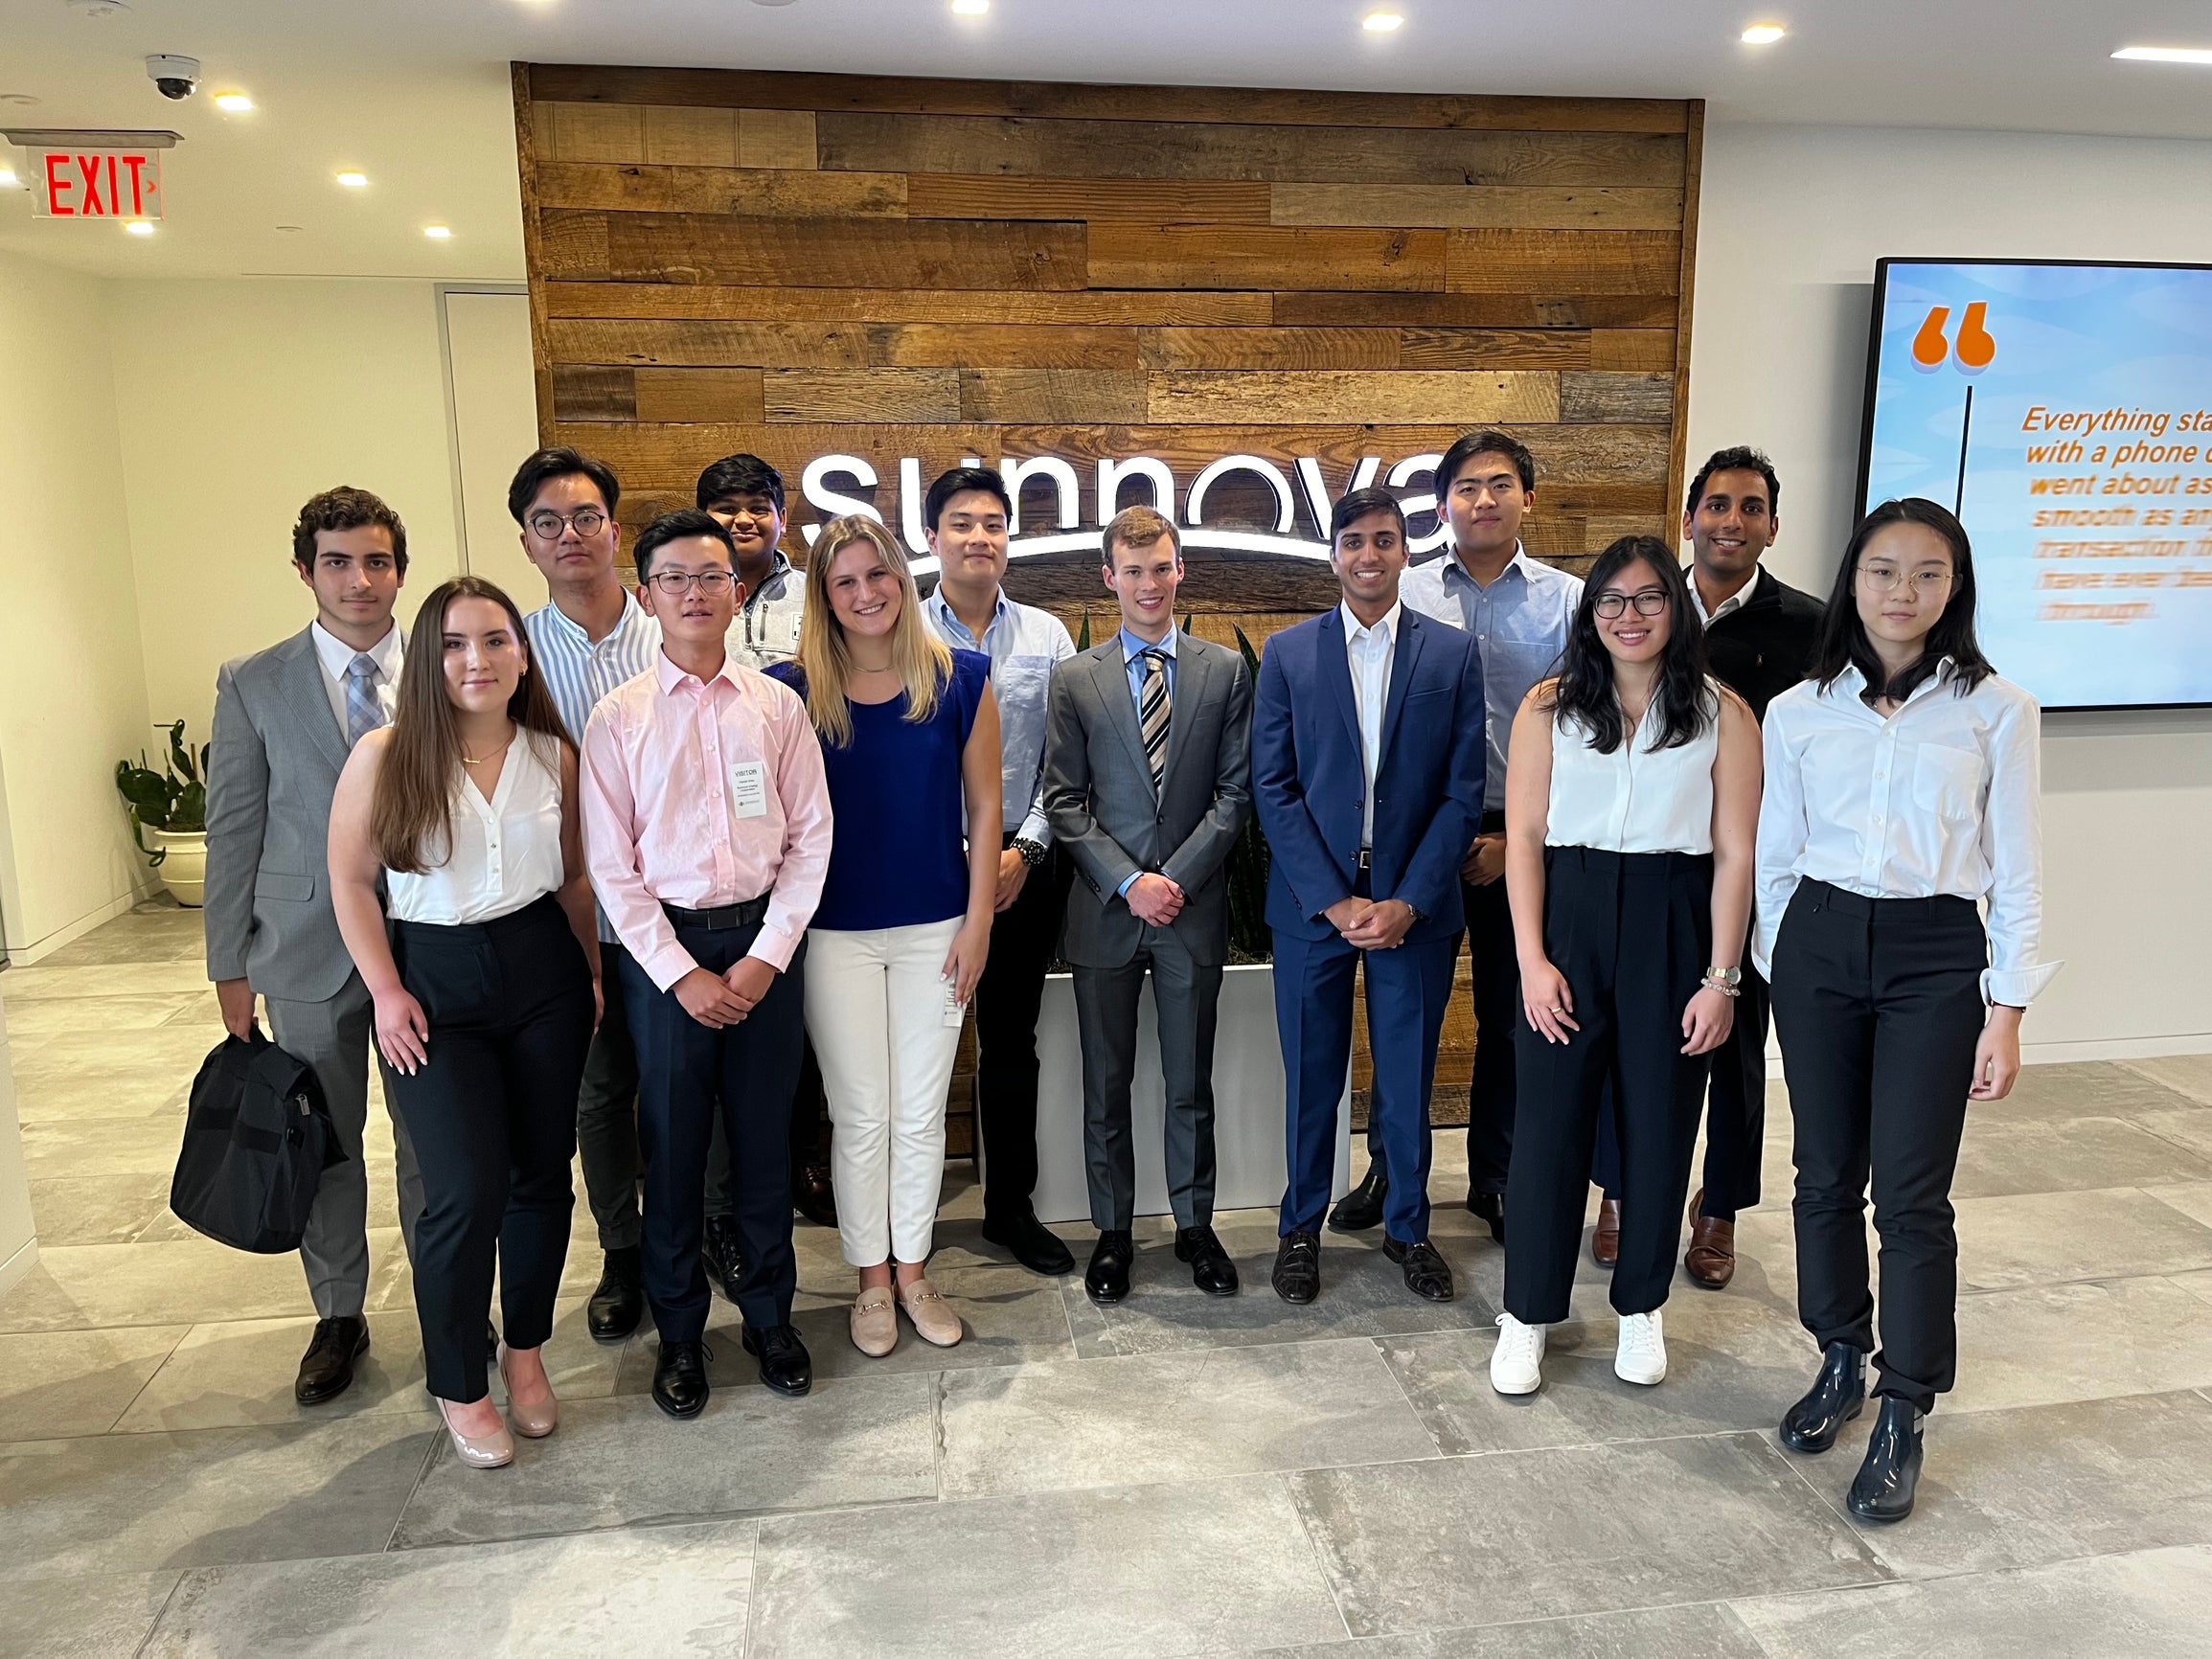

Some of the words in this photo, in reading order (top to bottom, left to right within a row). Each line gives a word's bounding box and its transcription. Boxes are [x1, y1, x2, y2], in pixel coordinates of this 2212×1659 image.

[45, 153, 147, 216] EXIT
[2021, 406, 2171, 438] Everything
[2026, 439, 2084, 464] with
[2090, 444, 2108, 464] a
[2110, 440, 2199, 469] phone
[2029, 474, 2097, 495] went
[2101, 472, 2180, 495] about
